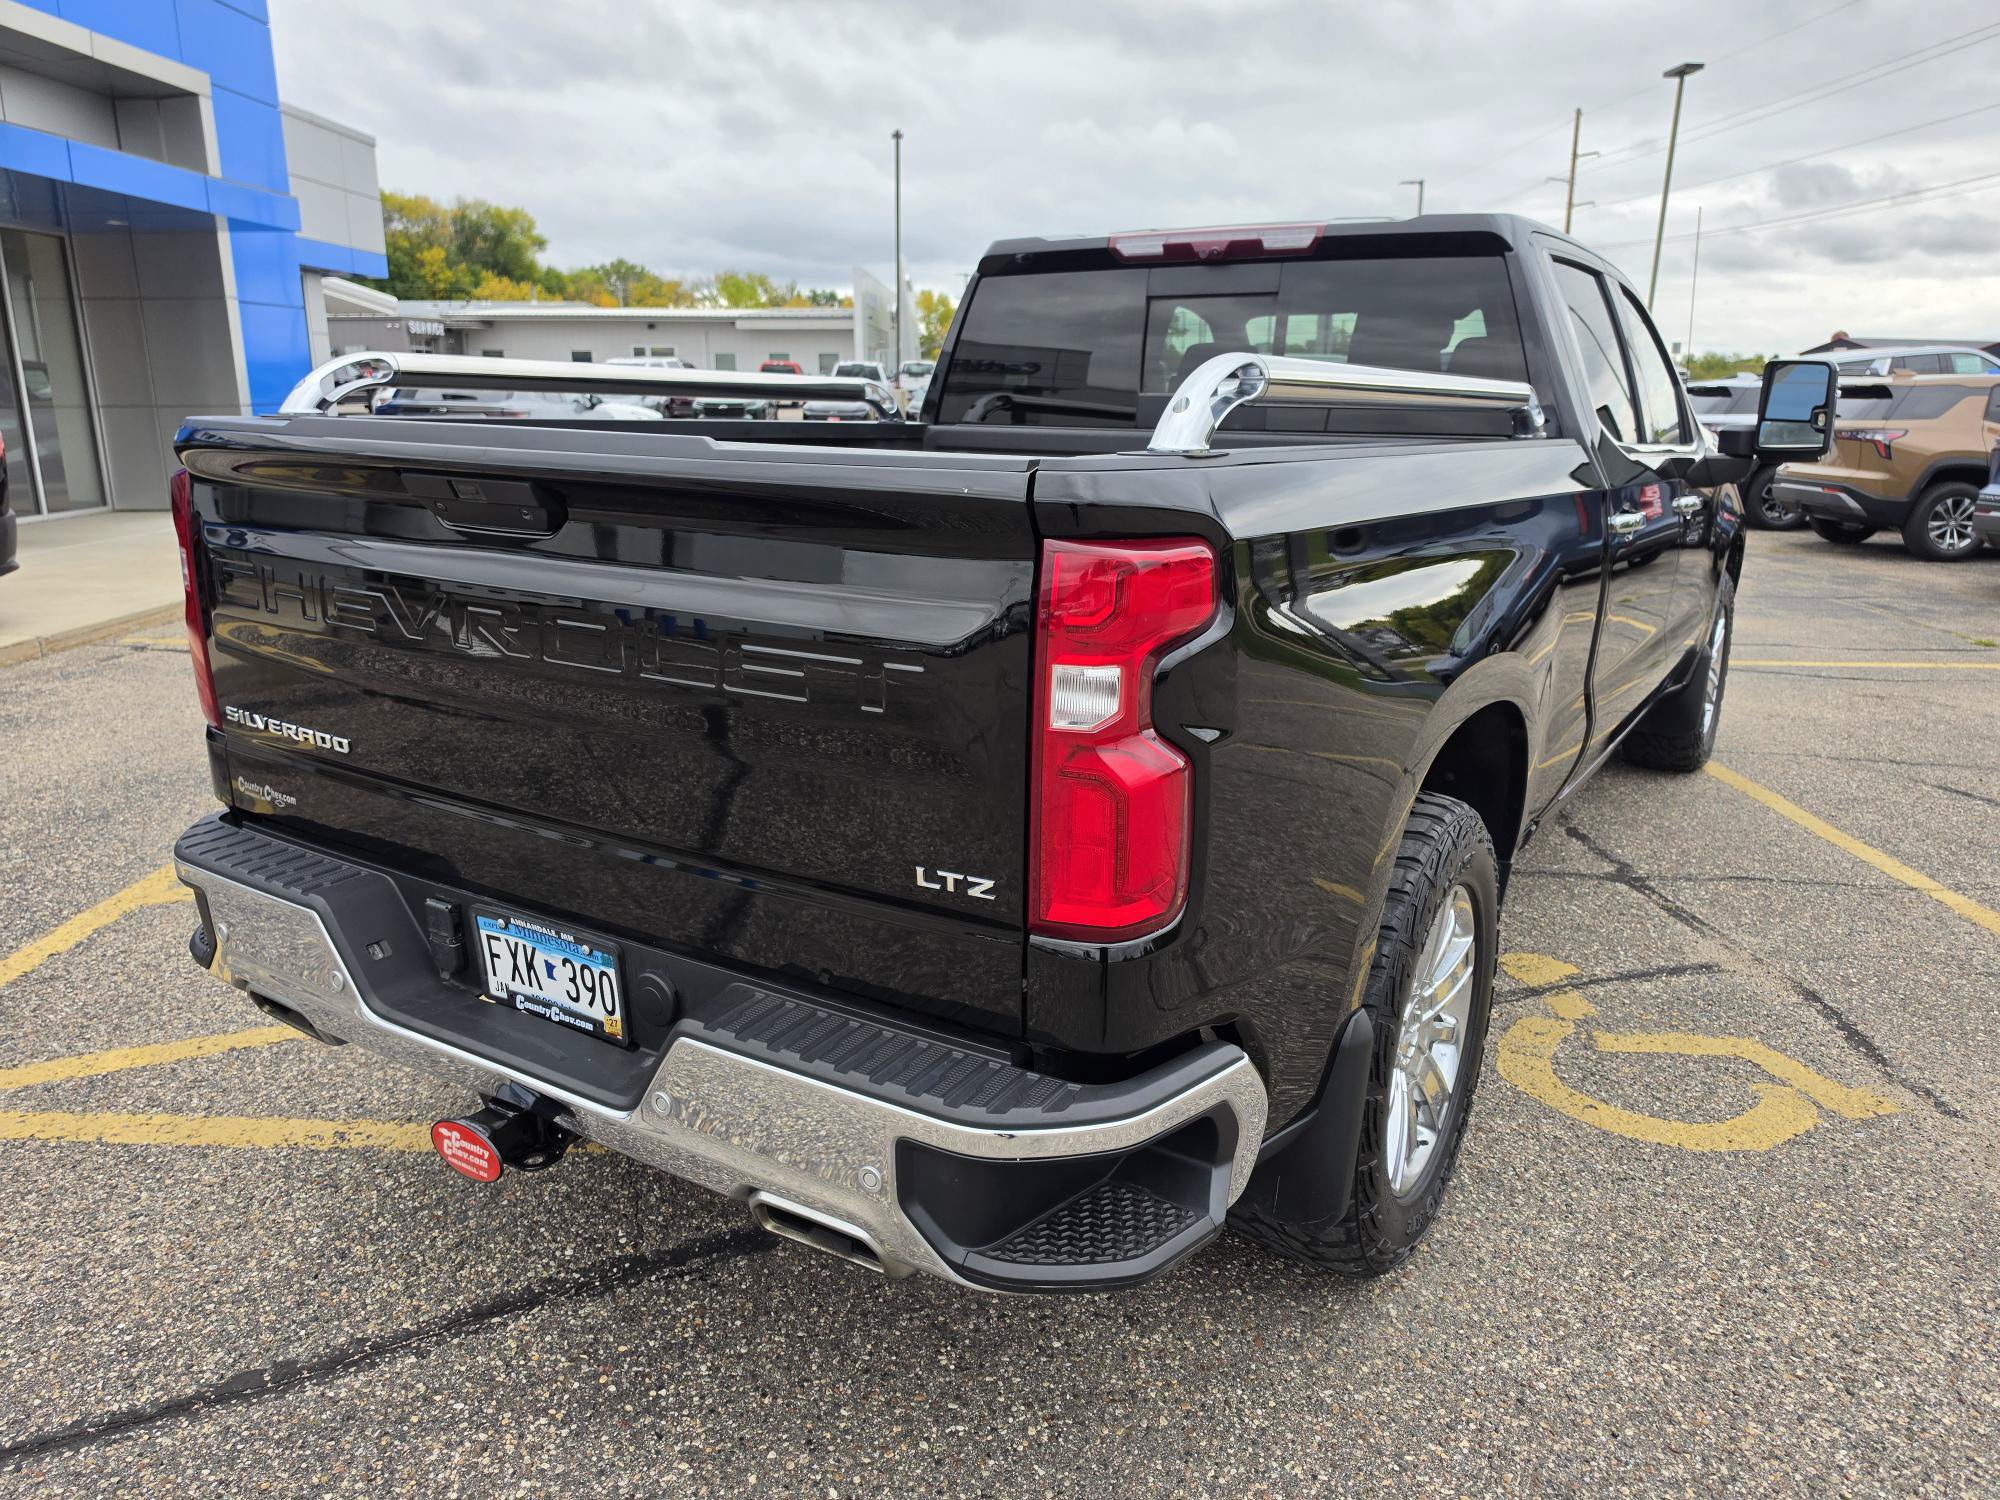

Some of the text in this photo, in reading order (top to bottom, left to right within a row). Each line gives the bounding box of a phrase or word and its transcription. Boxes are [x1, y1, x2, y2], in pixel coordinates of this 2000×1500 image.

[208, 555, 925, 713] CHEVROLET
[225, 705, 351, 754] SILVERADO
[915, 866, 997, 900] LTZ
[560, 932, 575, 943] MN
[486, 933, 616, 1016] FXK 390
[443, 1139, 488, 1168] Chev.com
[451, 1131, 489, 1160] Country
